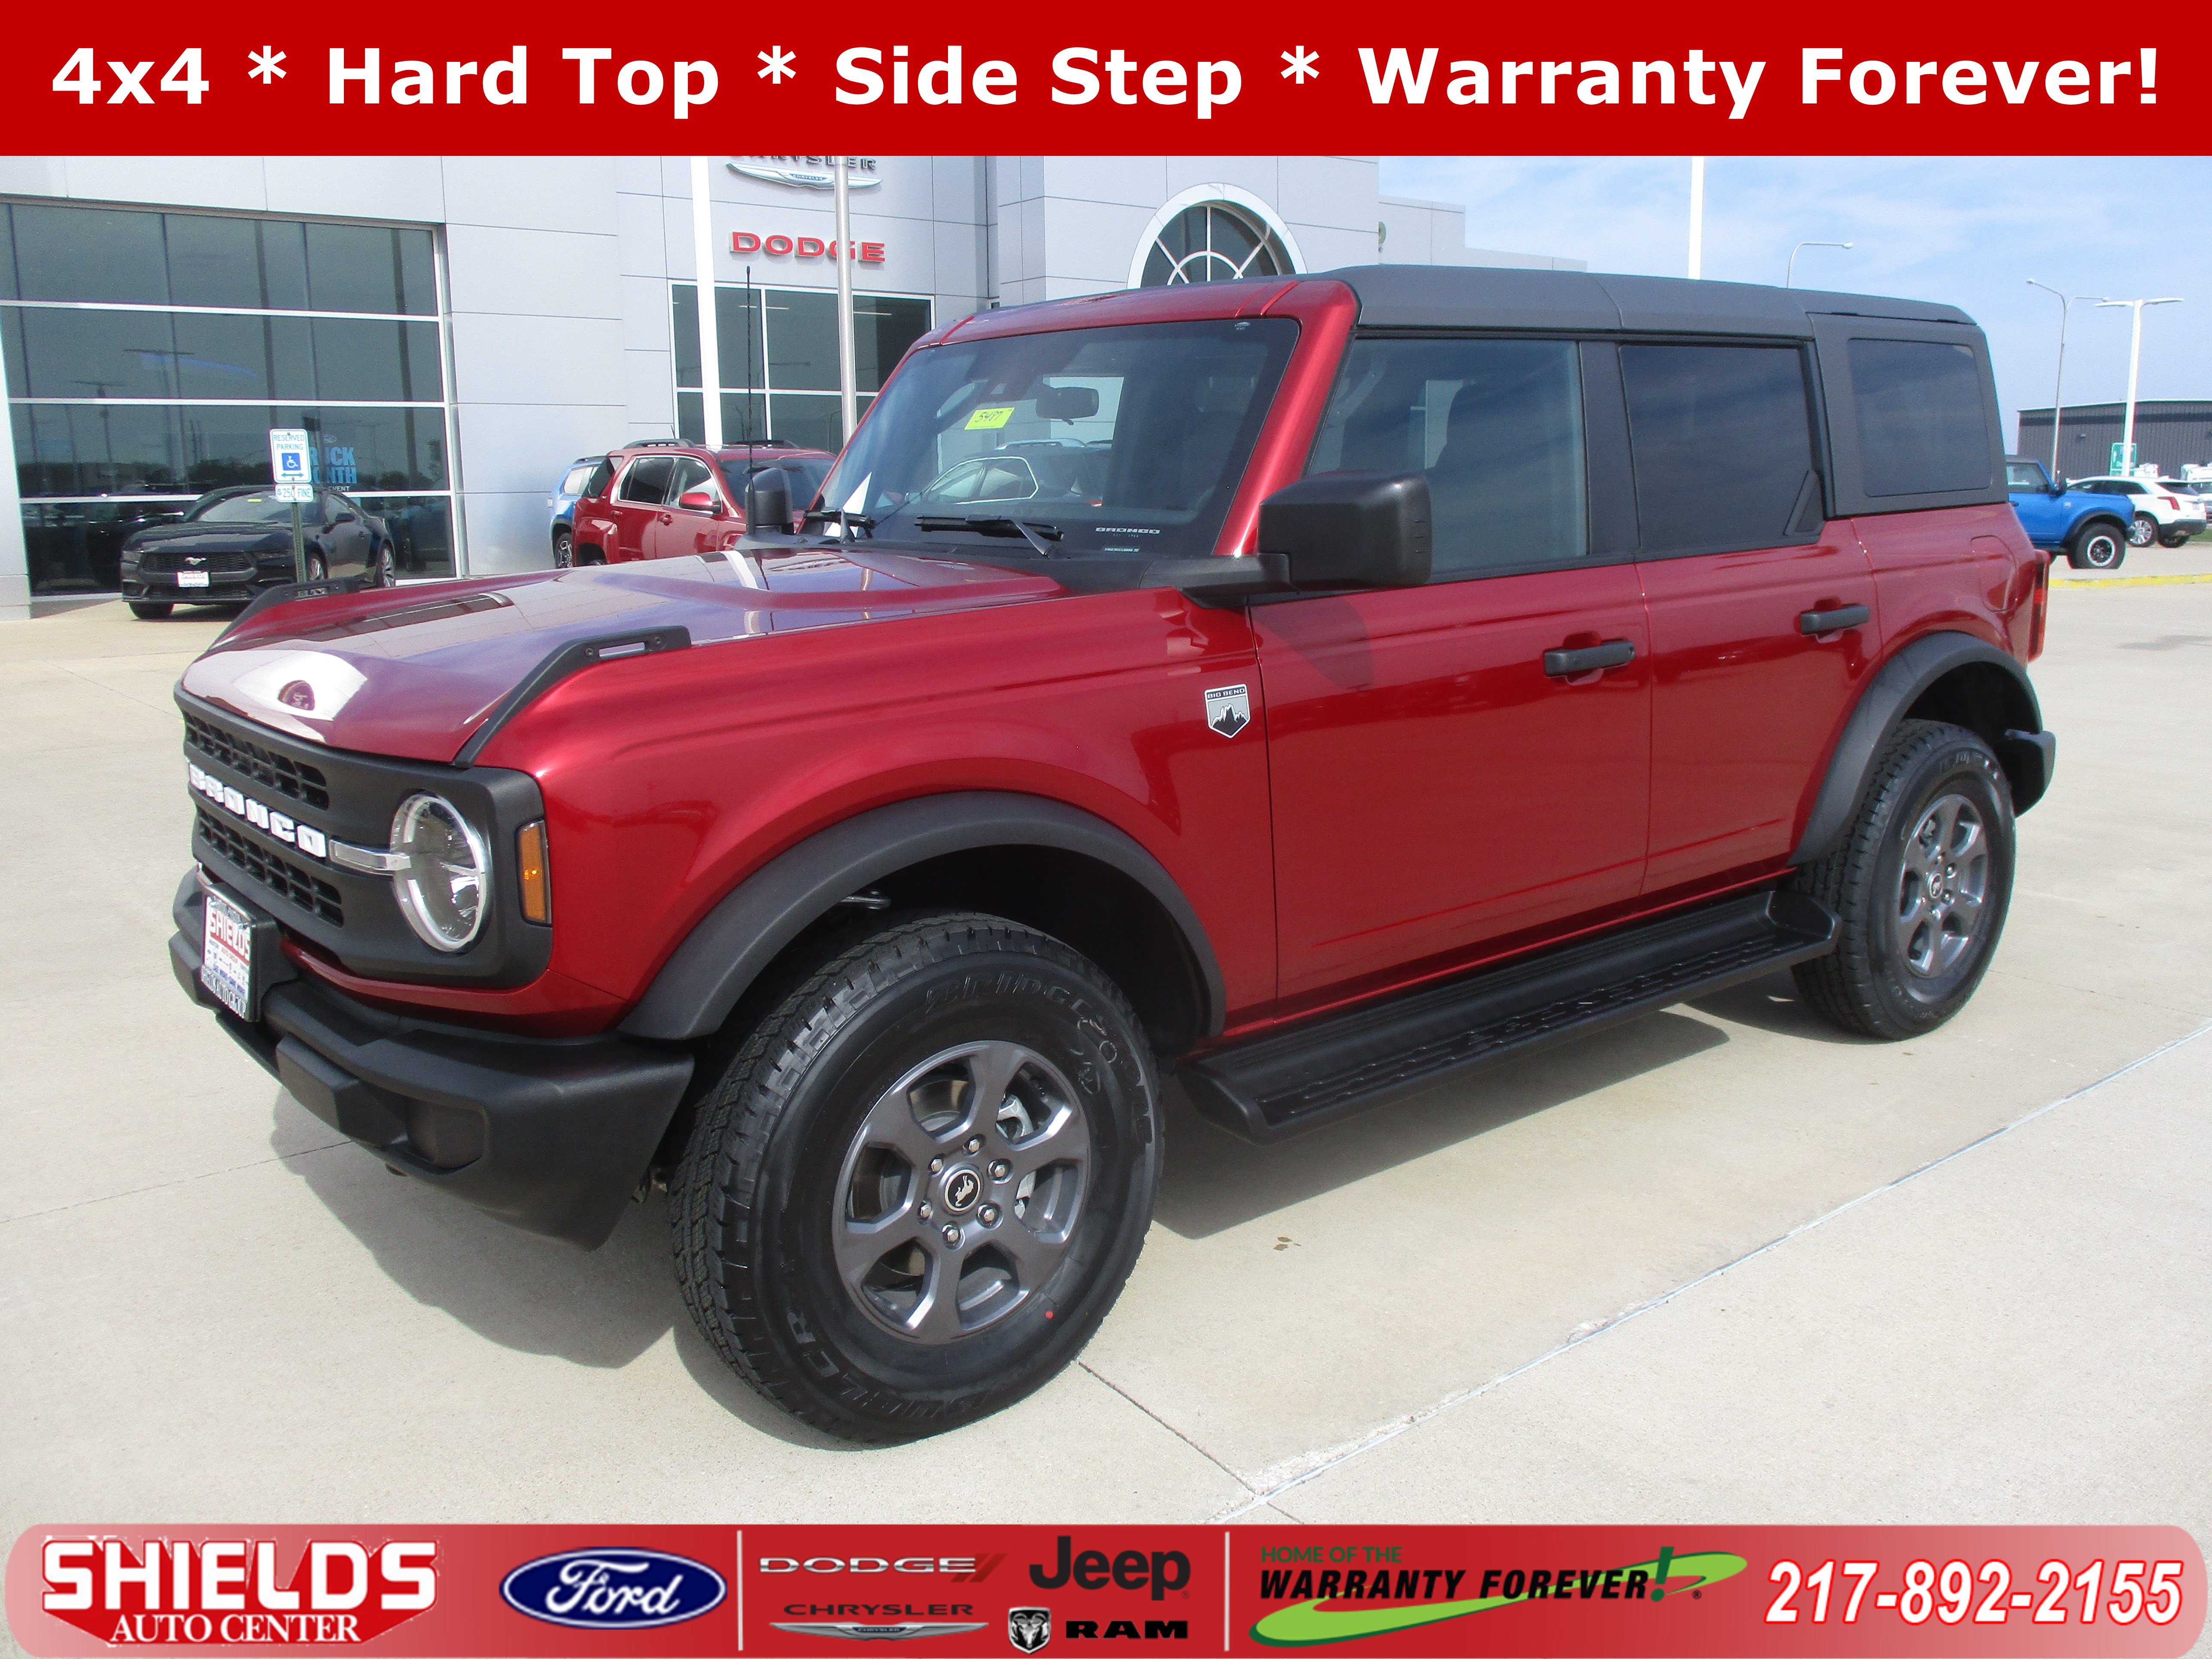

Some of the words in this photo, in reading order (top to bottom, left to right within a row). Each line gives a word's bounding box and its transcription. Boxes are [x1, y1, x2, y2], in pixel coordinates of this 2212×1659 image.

[731, 156, 877, 170] SLER
[298, 488, 312, 498] FINE
[189, 763, 326, 857] BRONCO
[210, 910, 250, 961] SHIELDS
